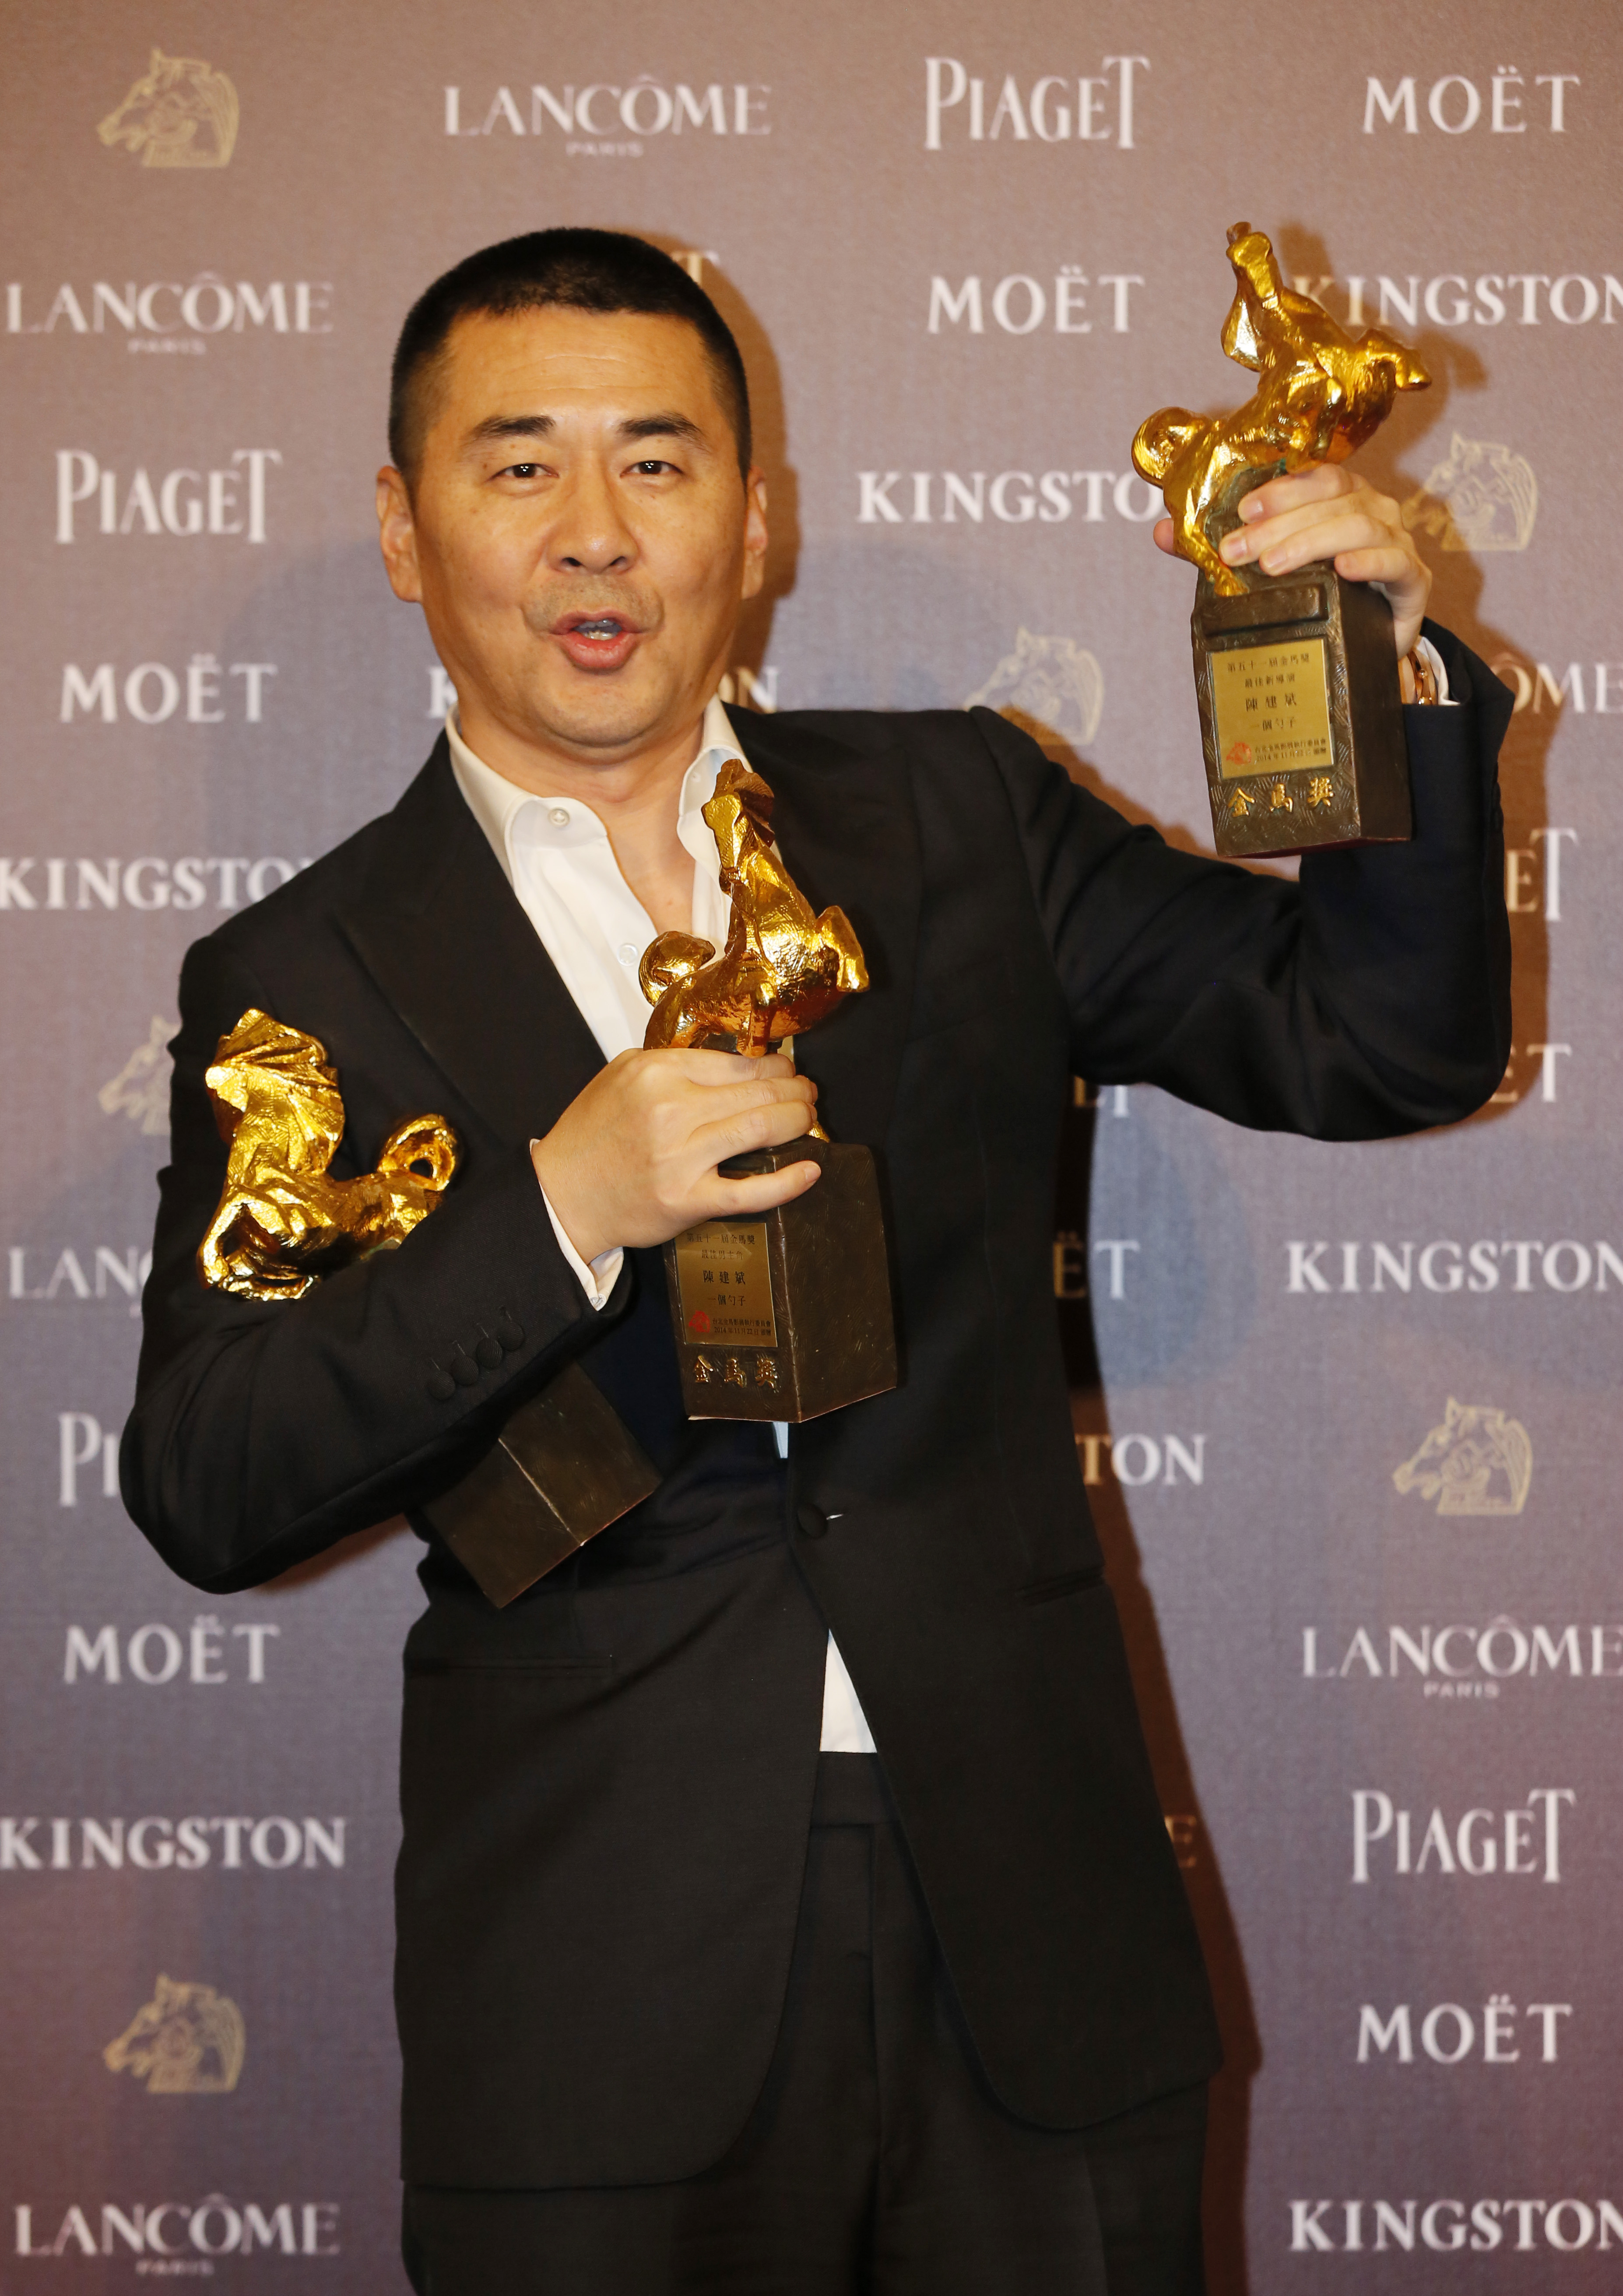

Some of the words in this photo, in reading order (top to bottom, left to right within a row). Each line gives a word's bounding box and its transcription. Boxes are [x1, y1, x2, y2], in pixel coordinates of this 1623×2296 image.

[444, 75, 771, 136] LANCÔME
[924, 56, 1150, 151] PIAGET
[1362, 65, 1581, 134] MOËT
[566, 141, 643, 157] PARIS
[6, 272, 334, 334] LANCÔME
[927, 265, 1145, 335] MOËT
[127, 338, 207, 355] PARIS
[56, 449, 282, 545] PIAGET
[857, 470, 1172, 524] KINGSTO
[60, 653, 278, 724] MOËT
[1246, 692, 1297, 711] 陳建斌
[0, 856, 313, 911] KINGSTO
[703, 1270, 745, 1285] 陳建斌
[708, 1294, 746, 1306] 一個勺子
[63, 1615, 281, 1684] MOËT
[1302, 1615, 1623, 1678] LANCÔME
[1423, 1681, 1500, 1698] PARIS
[0, 1816, 346, 1870] KINGSTON
[1351, 1788, 1576, 1883] PIAGET
[1356, 1994, 1573, 2063] MOËT
[14, 2194, 339, 2256] LANCÔME
[135, 2259, 214, 2276] PARIS
